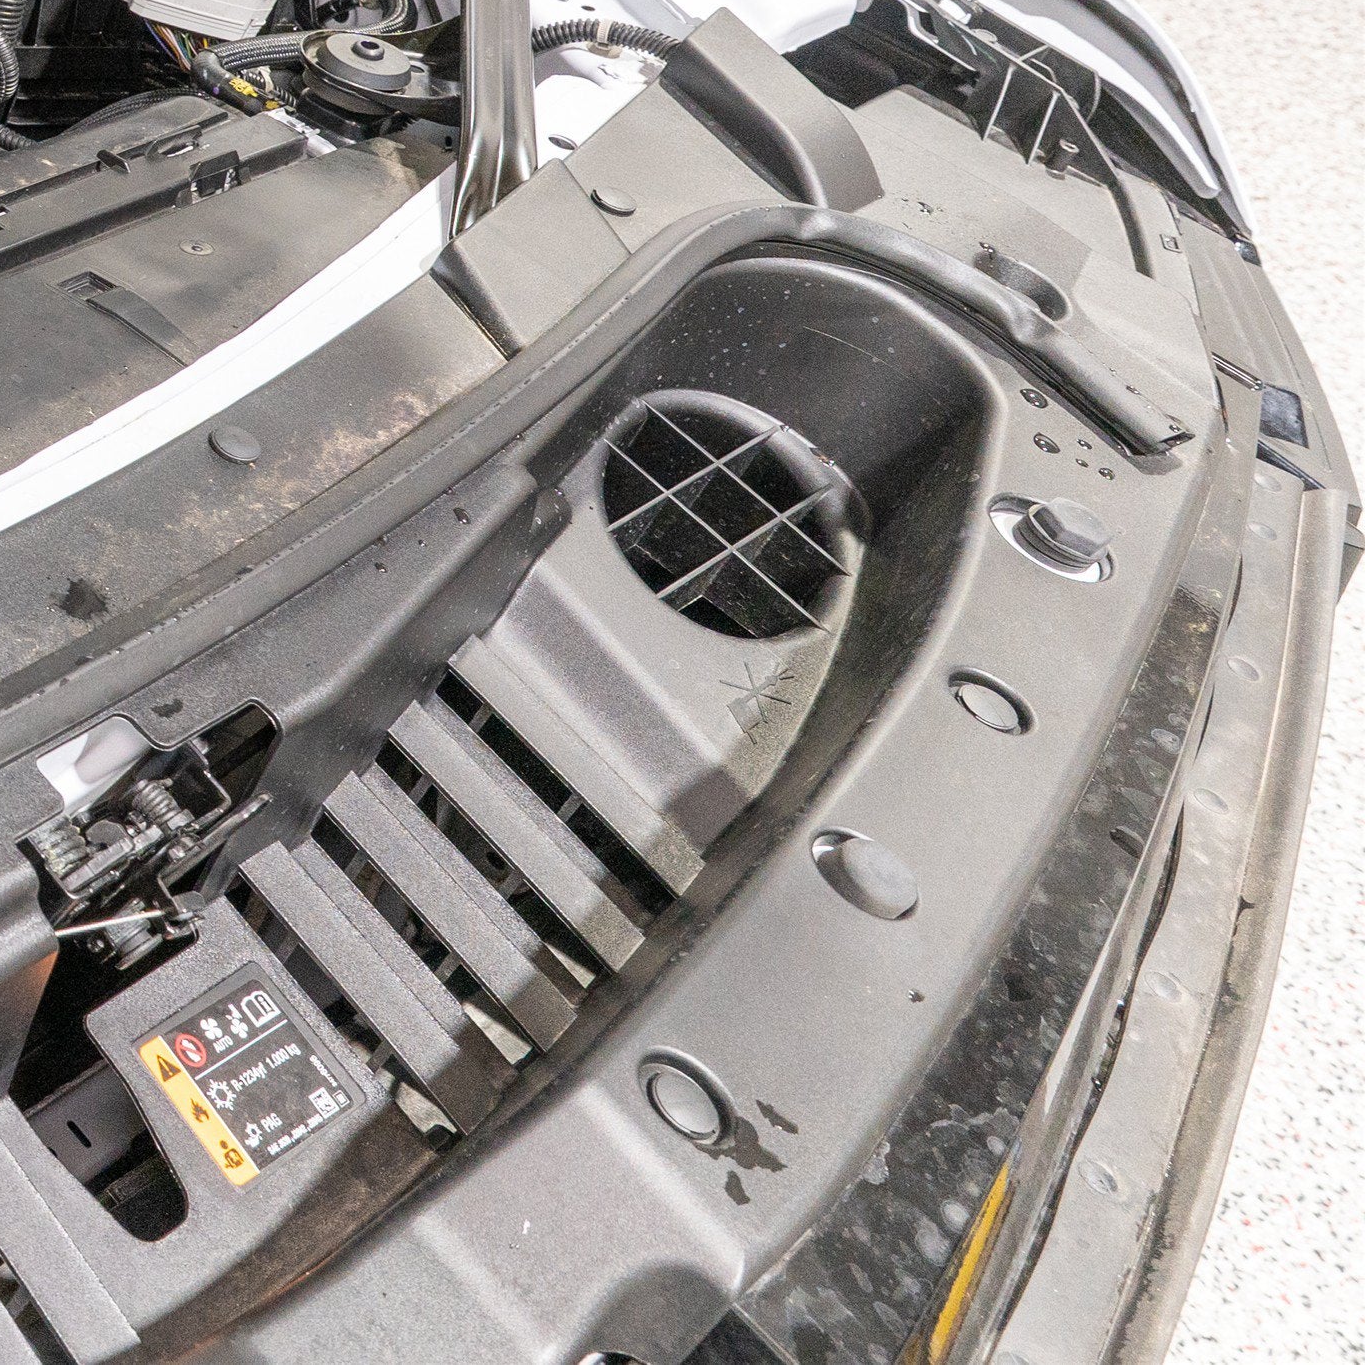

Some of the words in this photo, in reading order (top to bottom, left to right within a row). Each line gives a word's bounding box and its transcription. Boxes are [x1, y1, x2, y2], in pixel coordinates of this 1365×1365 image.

[212, 1035, 234, 1053] AUTO
[230, 1061, 268, 1092] R-1234yf
[265, 1048, 290, 1069] 1.000
[284, 1043, 302, 1057] kg
[260, 1112, 283, 1133] PAG
